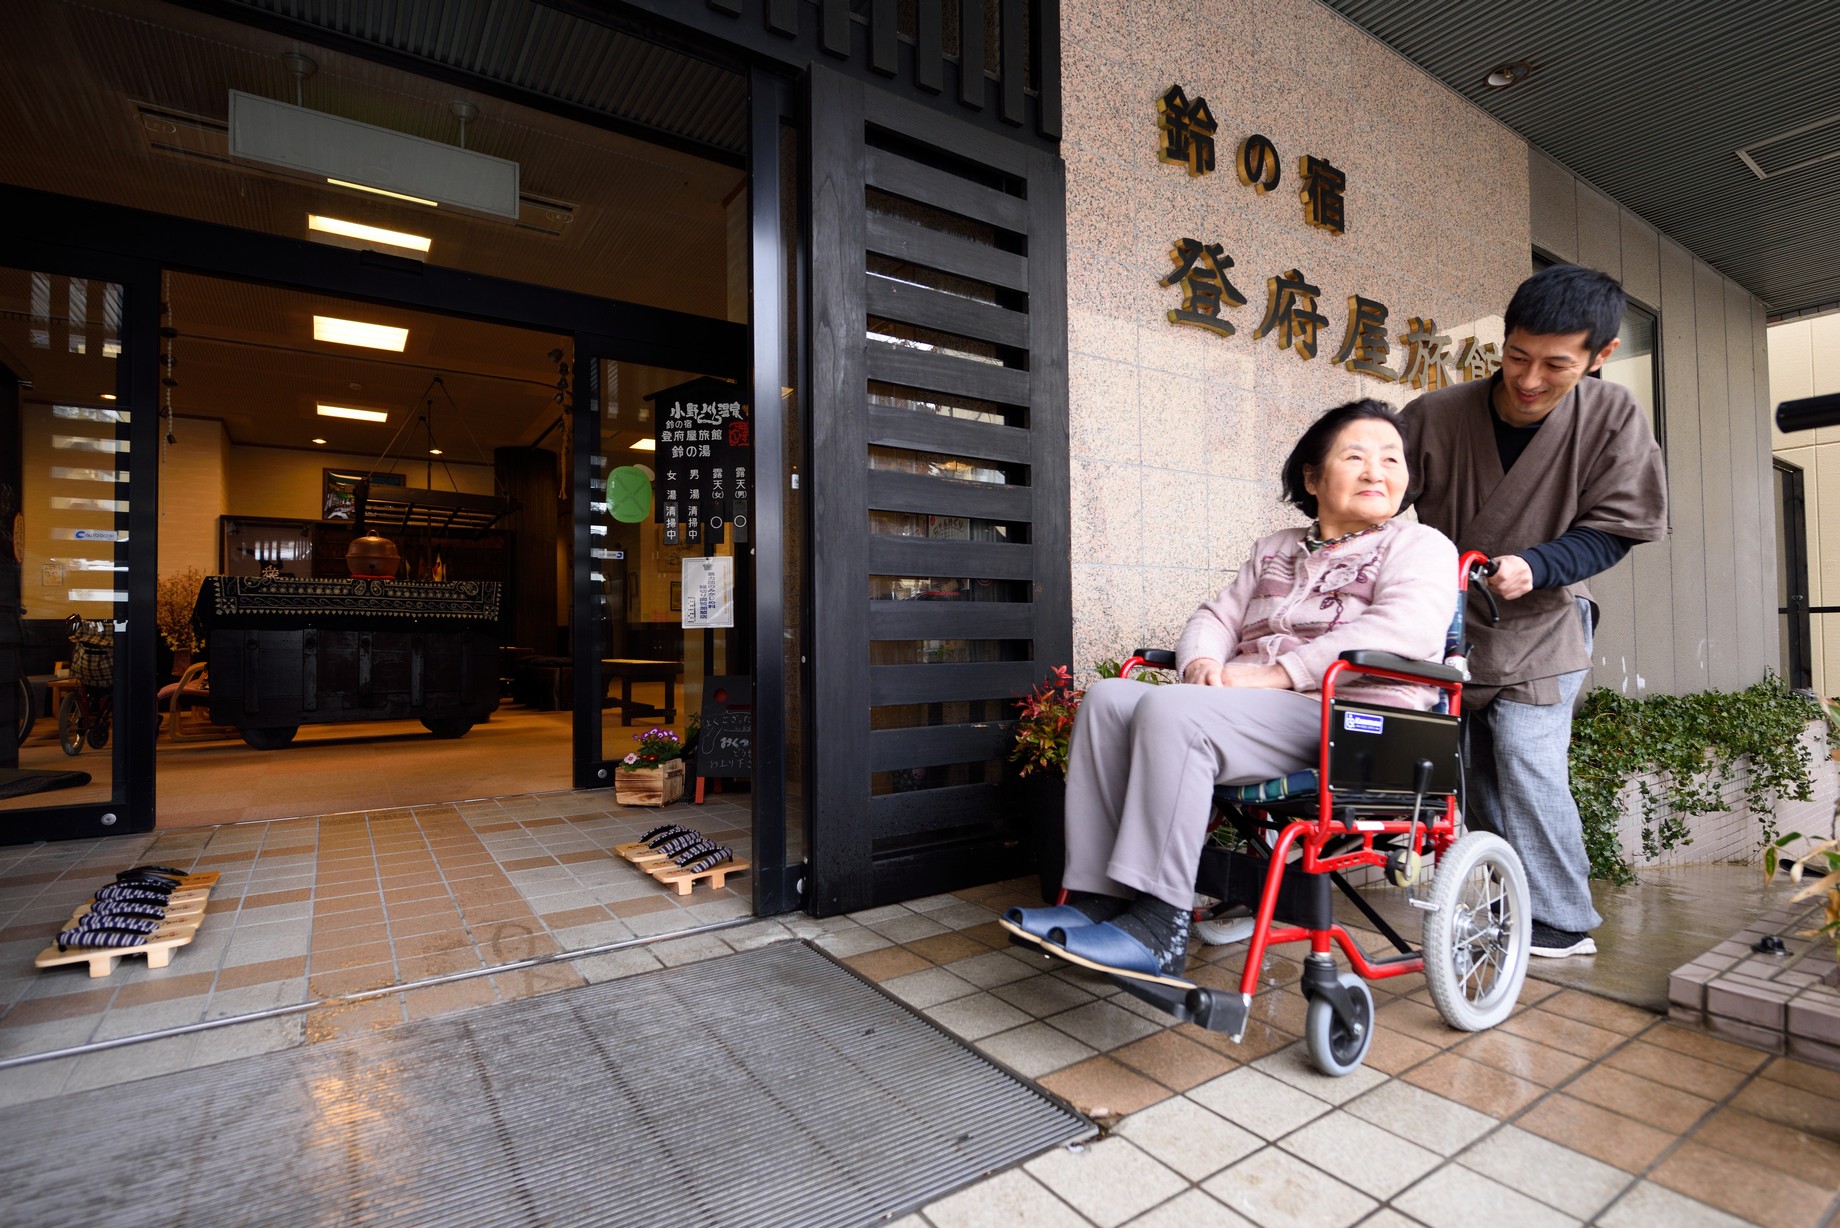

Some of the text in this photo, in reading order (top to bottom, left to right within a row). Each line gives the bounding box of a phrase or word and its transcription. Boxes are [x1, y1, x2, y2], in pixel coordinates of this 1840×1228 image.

[1157, 83, 1346, 236] 鈴の宿
[666, 420, 692, 429] 鈴の宿
[670, 401, 744, 425] 小野川温泉
[661, 429, 723, 442] 登府屋旅館
[672, 445, 711, 458] 鈴の湯
[666, 505, 676, 540] 清掃中
[688, 505, 698, 540] 清掃中
